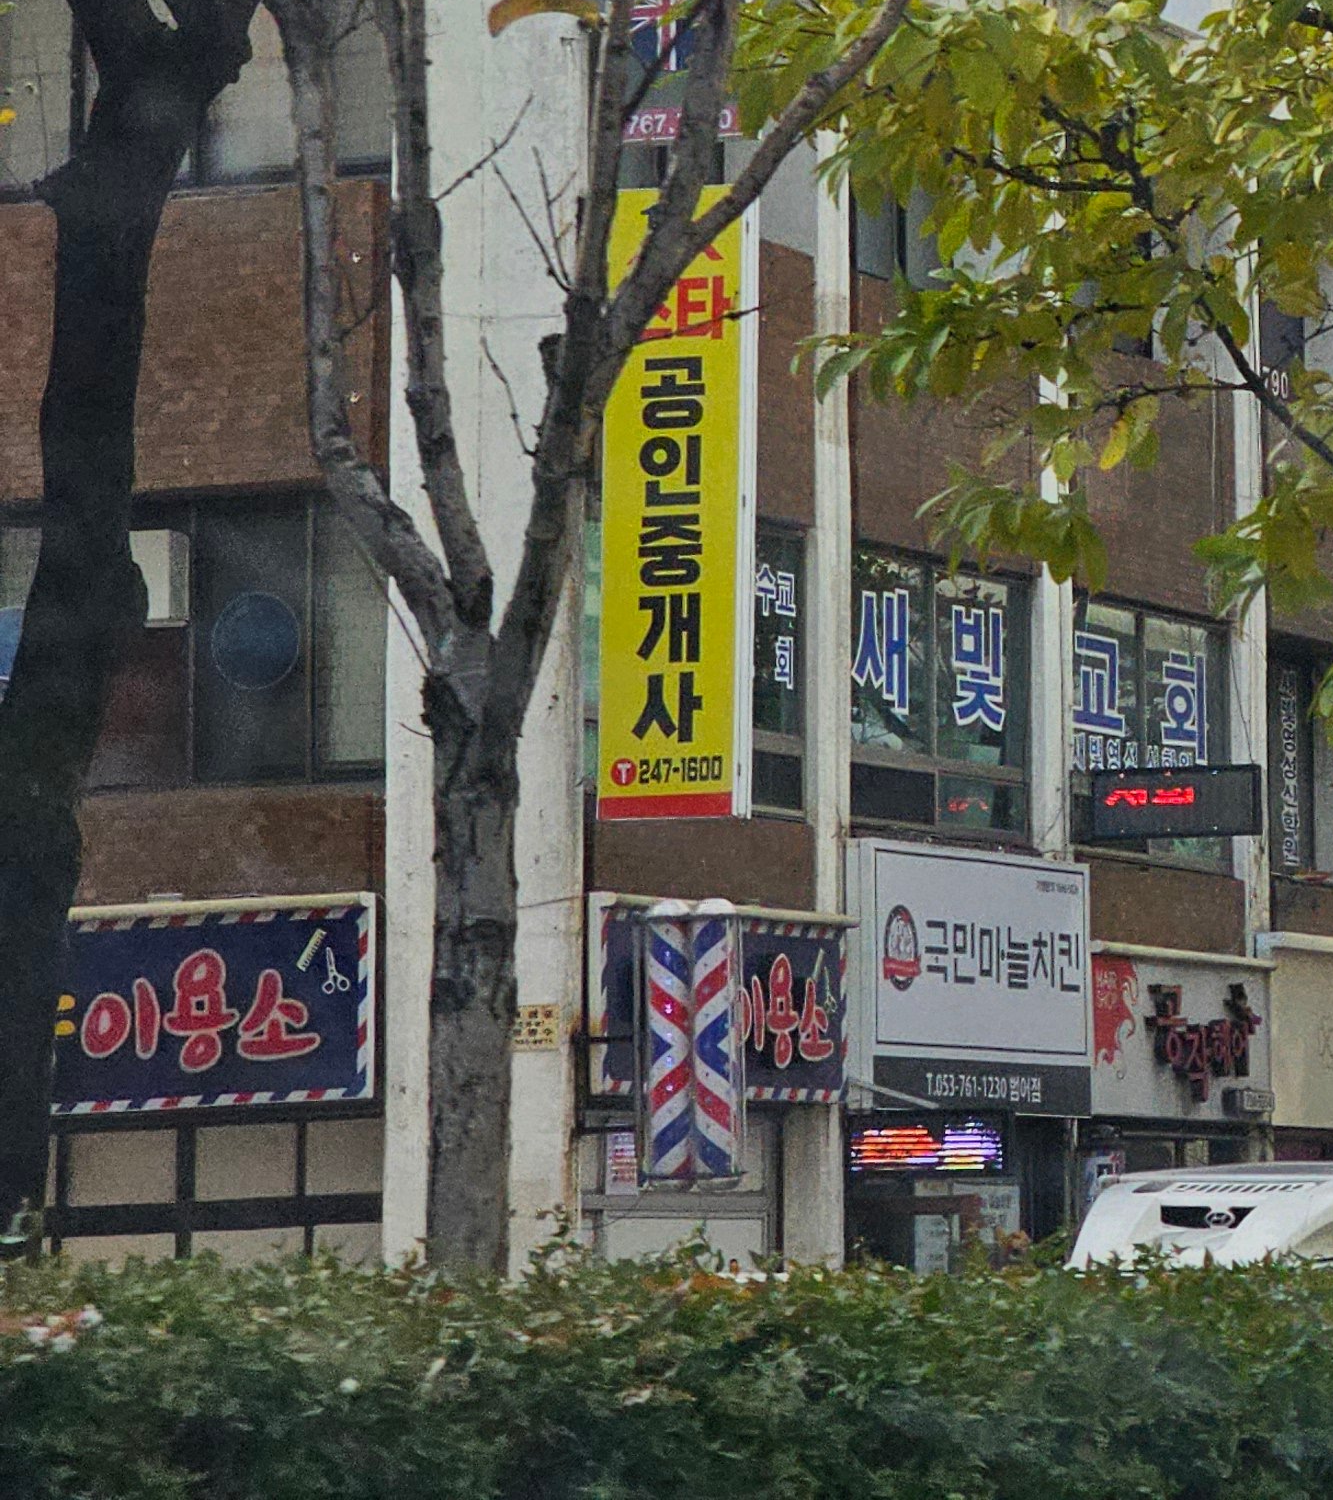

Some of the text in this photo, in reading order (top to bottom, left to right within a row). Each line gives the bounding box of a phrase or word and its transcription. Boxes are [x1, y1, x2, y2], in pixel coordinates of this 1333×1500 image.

[631, 355, 706, 744] 공인중개사
[638, 753, 723, 785] 247-1600
[924, 919, 1081, 992] 국민마늘치킨
[80, 947, 321, 1073] 이용소
